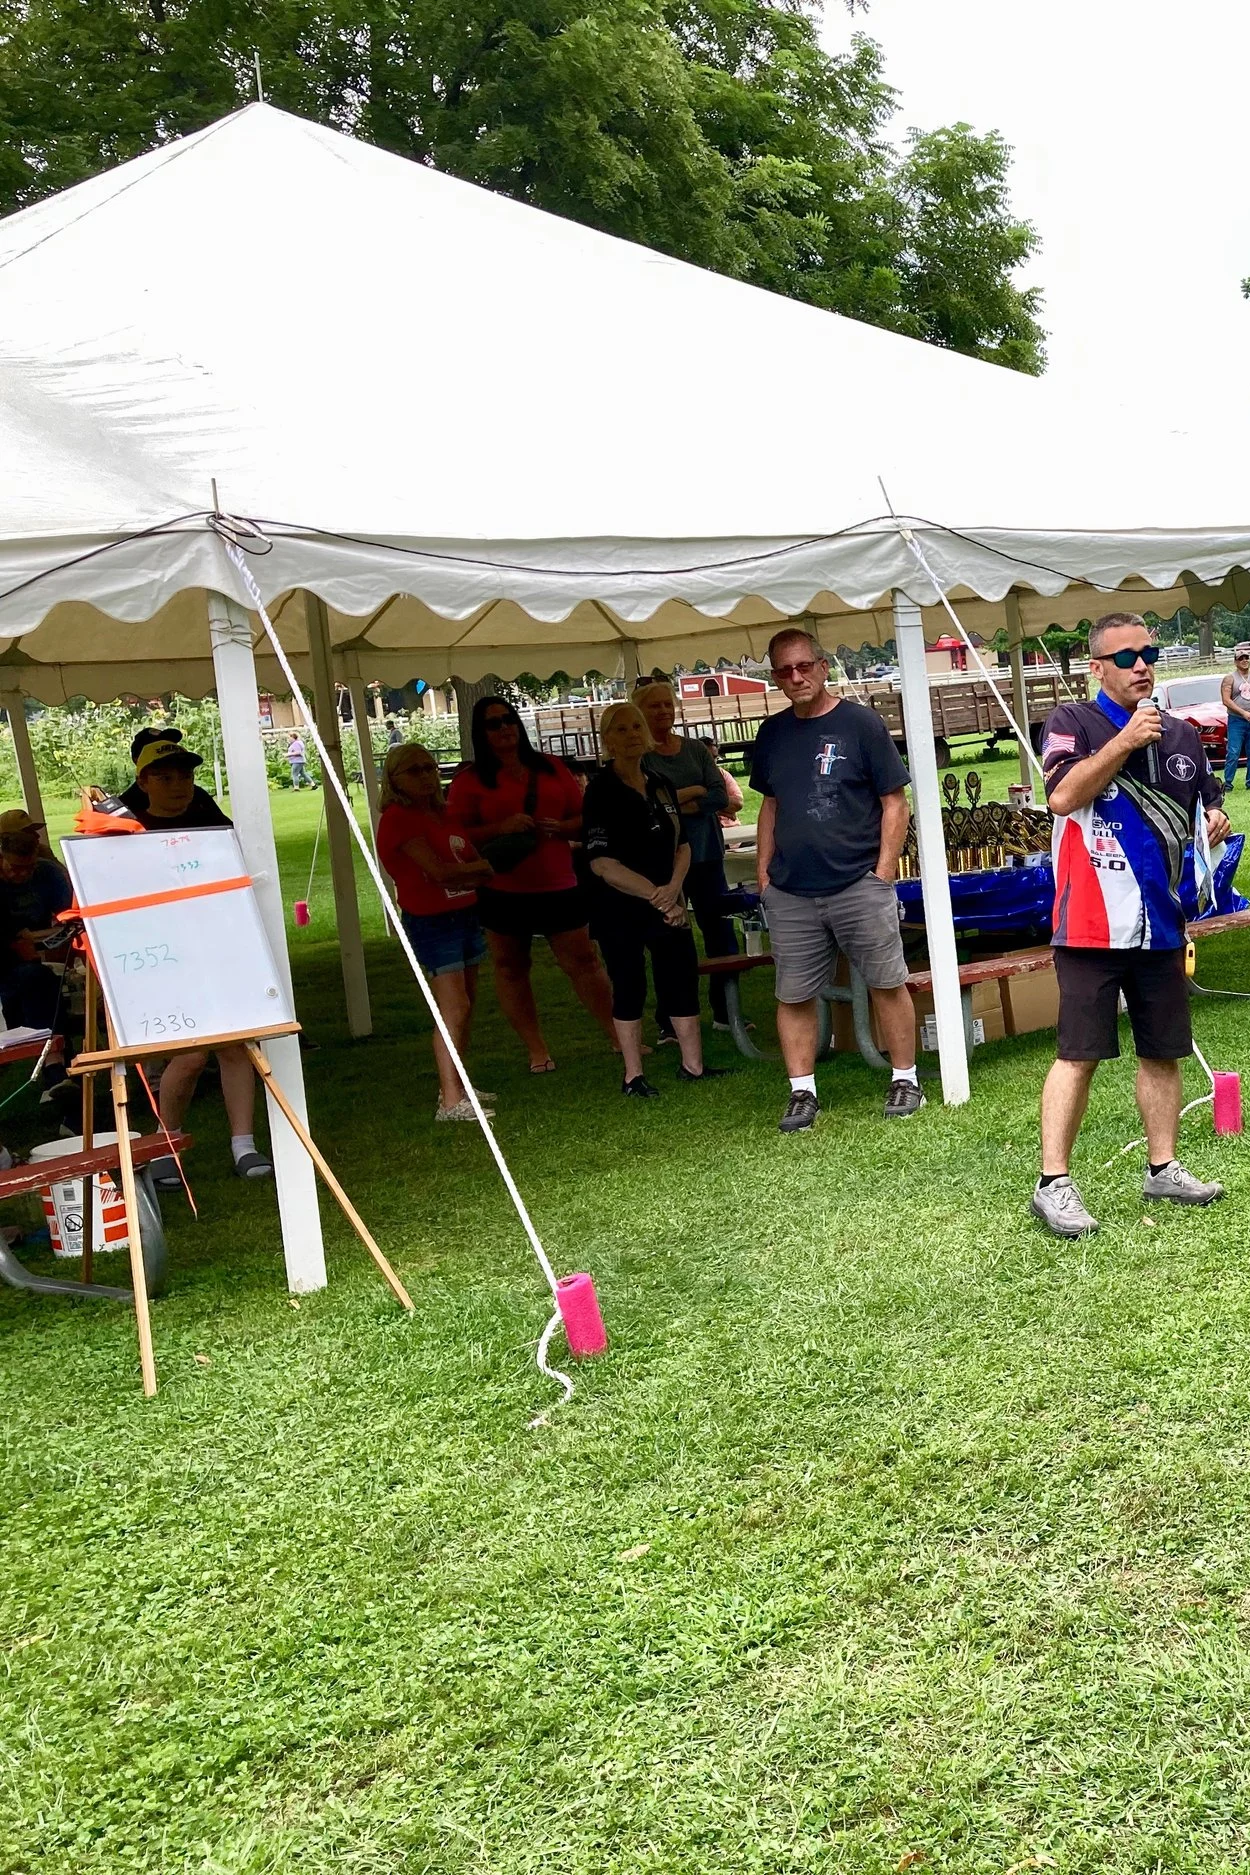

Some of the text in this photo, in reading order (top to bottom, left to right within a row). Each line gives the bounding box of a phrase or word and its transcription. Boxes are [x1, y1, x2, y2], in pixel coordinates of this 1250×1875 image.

[1092, 819, 1123, 831] SVO
[1090, 856, 1126, 871] 5.0
[114, 944, 178, 974] 7352
[140, 1013, 196, 1037] 7336
